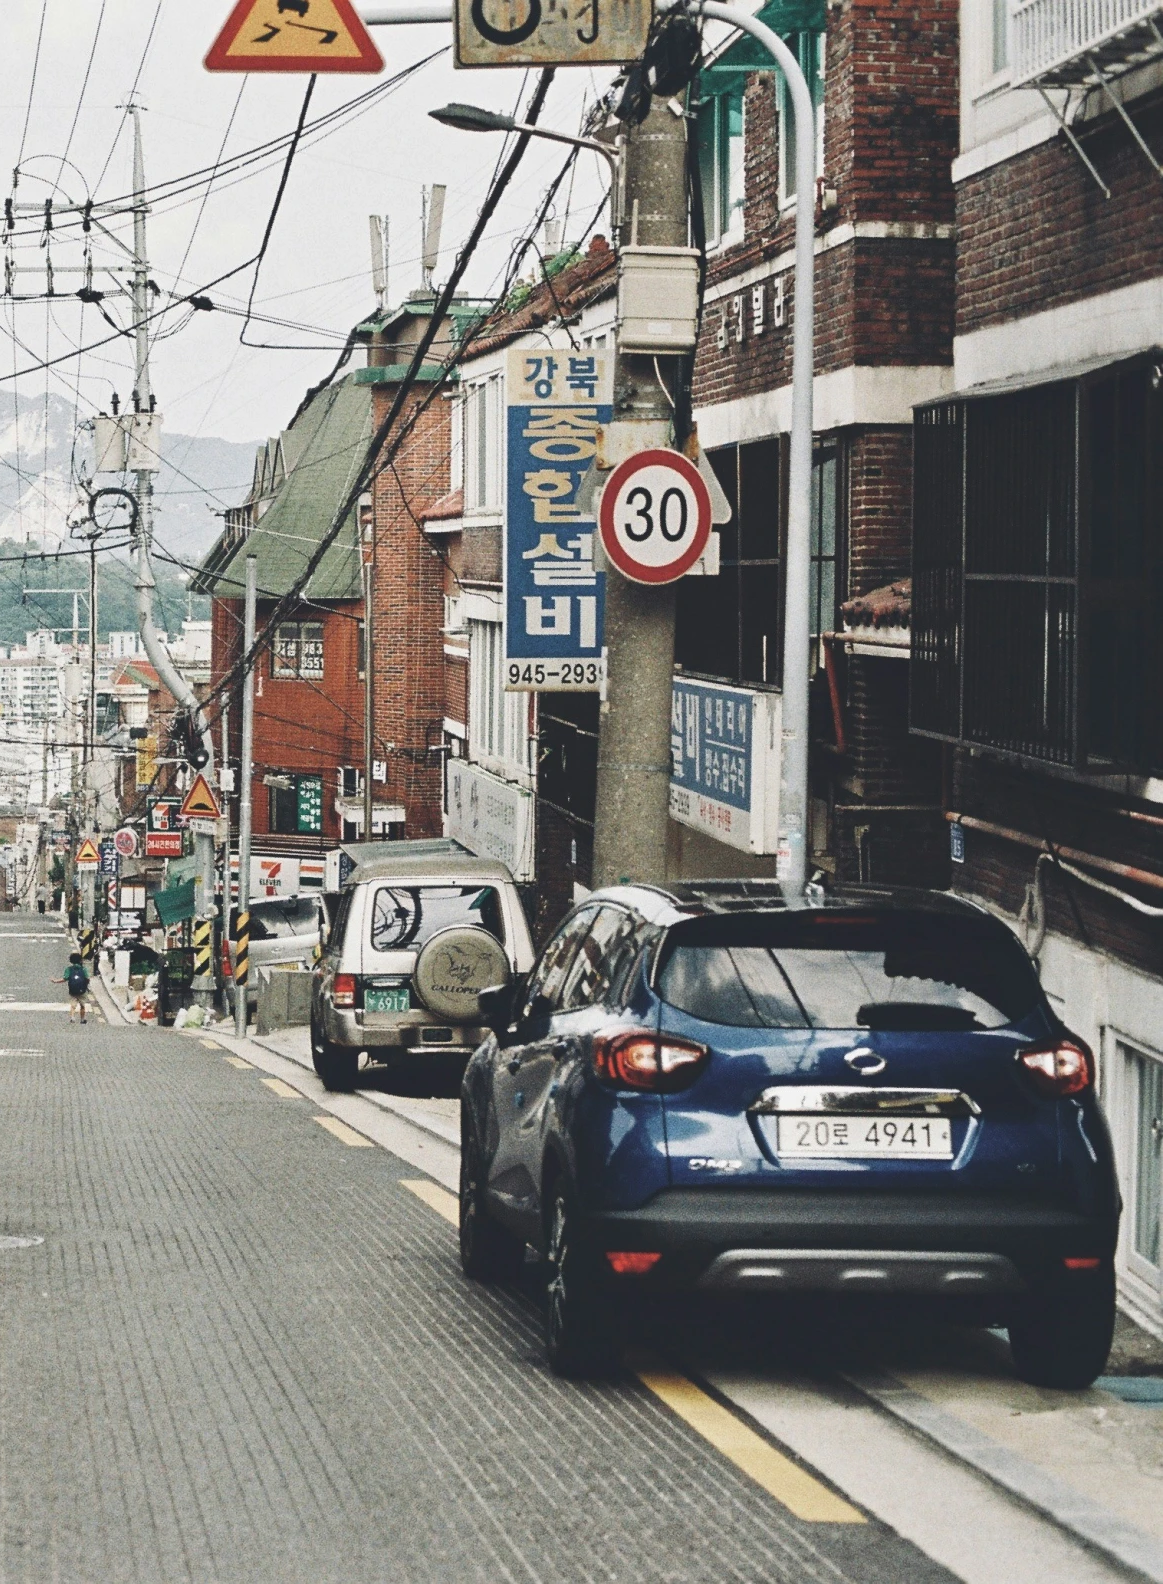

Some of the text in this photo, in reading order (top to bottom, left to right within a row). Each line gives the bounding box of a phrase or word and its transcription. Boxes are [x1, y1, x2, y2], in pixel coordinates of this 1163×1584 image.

[524, 356, 599, 399] 강북
[624, 486, 688, 542] 30
[377, 997, 407, 1011] 6917
[797, 1122, 932, 1147] 20로 4941
